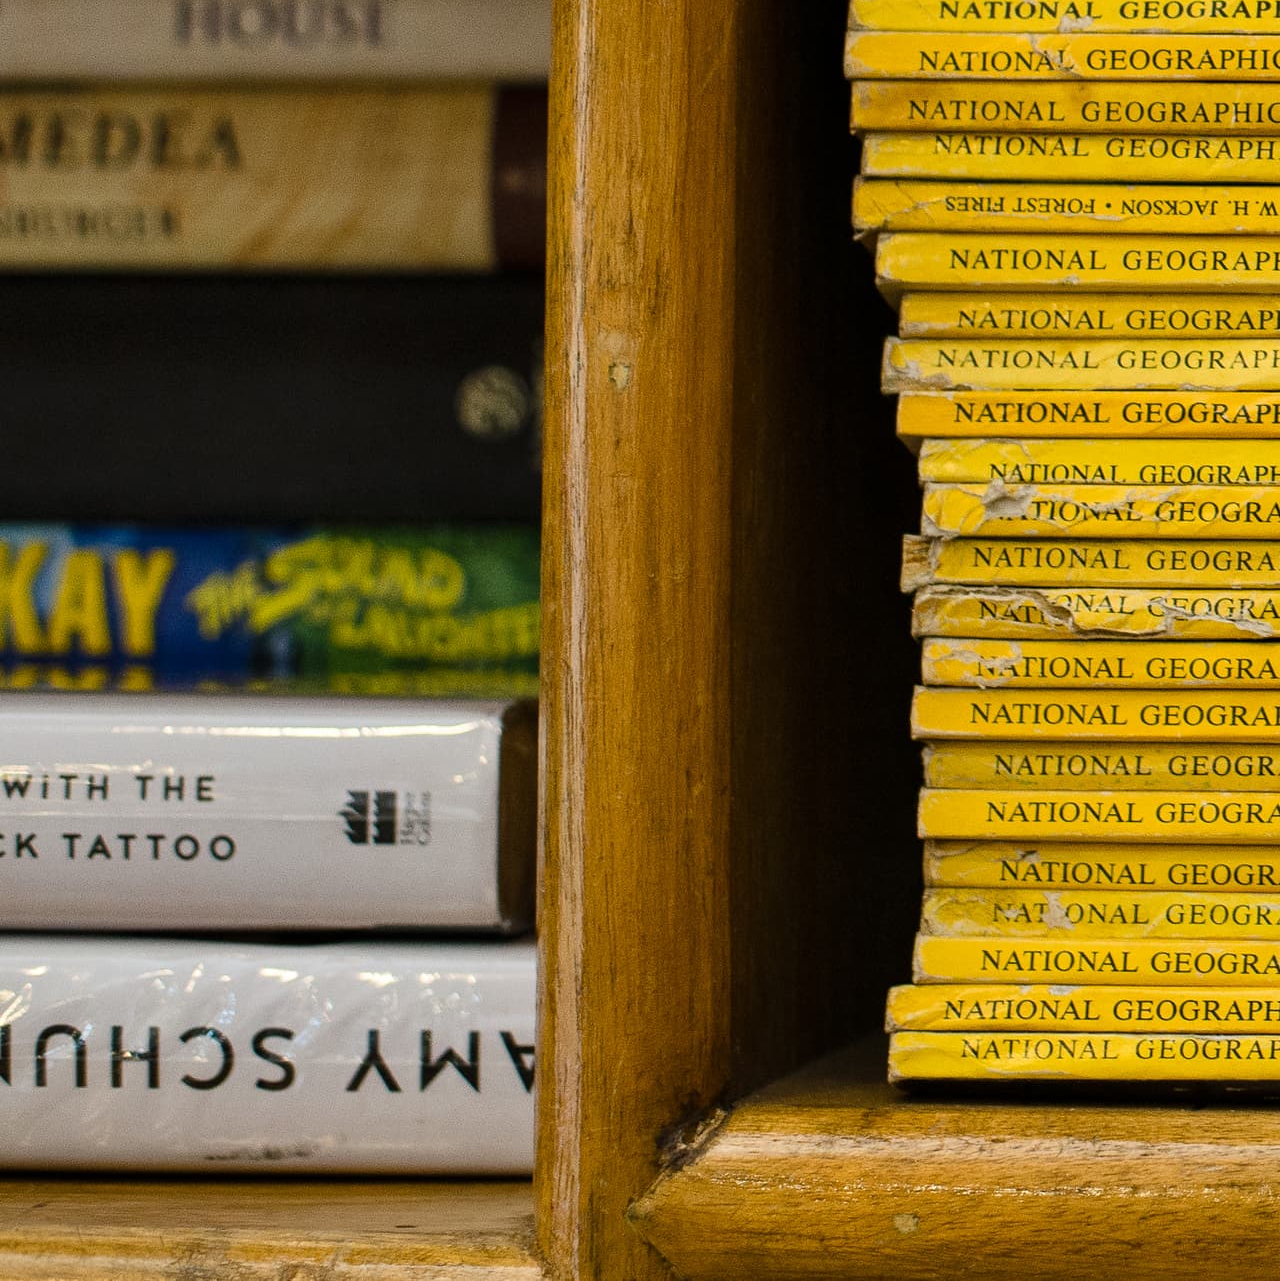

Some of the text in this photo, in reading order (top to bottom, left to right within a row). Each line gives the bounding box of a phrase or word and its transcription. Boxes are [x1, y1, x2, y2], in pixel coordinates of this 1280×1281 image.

[919, 49, 1075, 72] NATIONAL
[953, 402, 1110, 423] NATIONAL
[976, 656, 1134, 679] NATIONAL
[3, 774, 217, 802] WITH THE
[62, 833, 238, 862] TATTOO
[981, 950, 1139, 973] NATIONAL
[943, 999, 1101, 1020] NATIONAL
